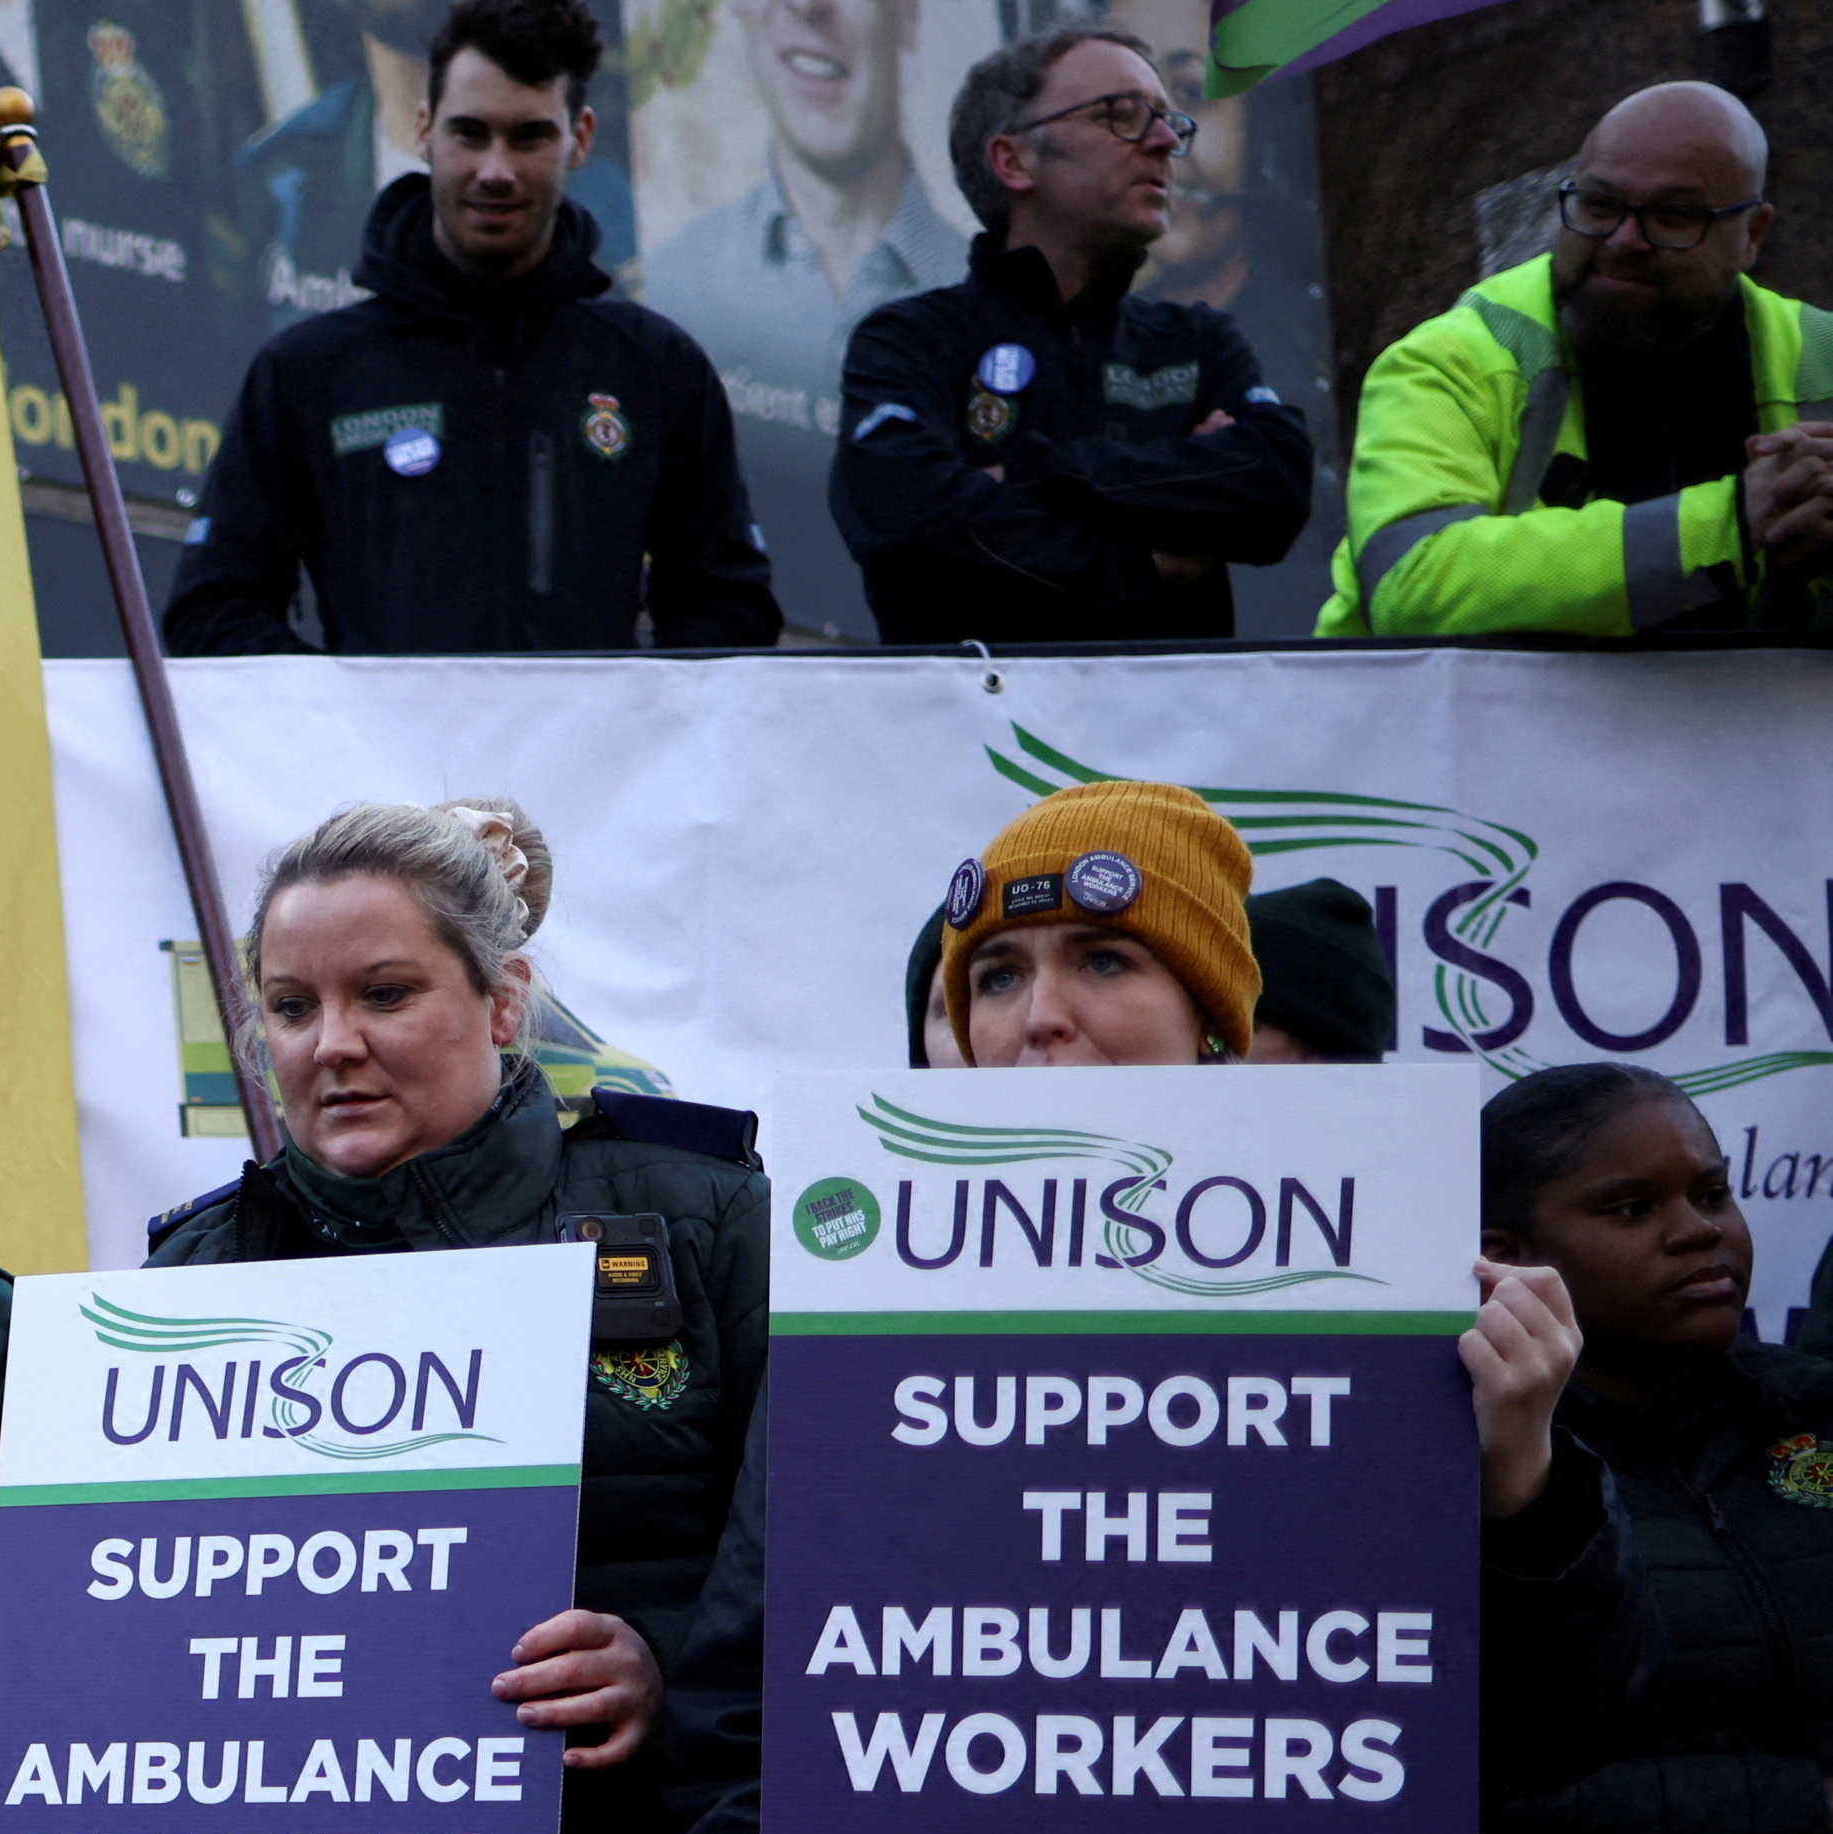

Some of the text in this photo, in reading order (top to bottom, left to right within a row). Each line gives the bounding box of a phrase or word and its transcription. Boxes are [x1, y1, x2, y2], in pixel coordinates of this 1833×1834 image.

[61, 216, 188, 282] nurse
[5, 383, 223, 477] odon
[1071, 854, 1135, 901] LONDON AMBULANCE SERVICE
[1081, 874, 1124, 893] AMBULANCE
[1083, 881, 1118, 897] WORKERS
[1091, 865, 1124, 880] SUPPORT
[1098, 874, 1113, 882] THE
[811, 1195, 837, 1213] BACK
[835, 1187, 855, 1203] THE
[811, 1209, 866, 1239] TO PUT NHS
[815, 1201, 855, 1224] STRIKES
[895, 1176, 1356, 1270] UNISON
[612, 1260, 646, 1268] WARNING
[819, 1221, 867, 1248] PAY RIGHT
[100, 1348, 483, 1446] UNISON
[890, 1375, 1351, 1447] SUPPORT
[1023, 1491, 1213, 1564] THE
[86, 1527, 468, 1601] SUPPORT
[188, 1634, 347, 1700] THE
[804, 1605, 1434, 1684] AMBULANCE
[5, 1736, 525, 1806] AMBULANCE
[830, 1711, 1405, 1801] WORKERS
